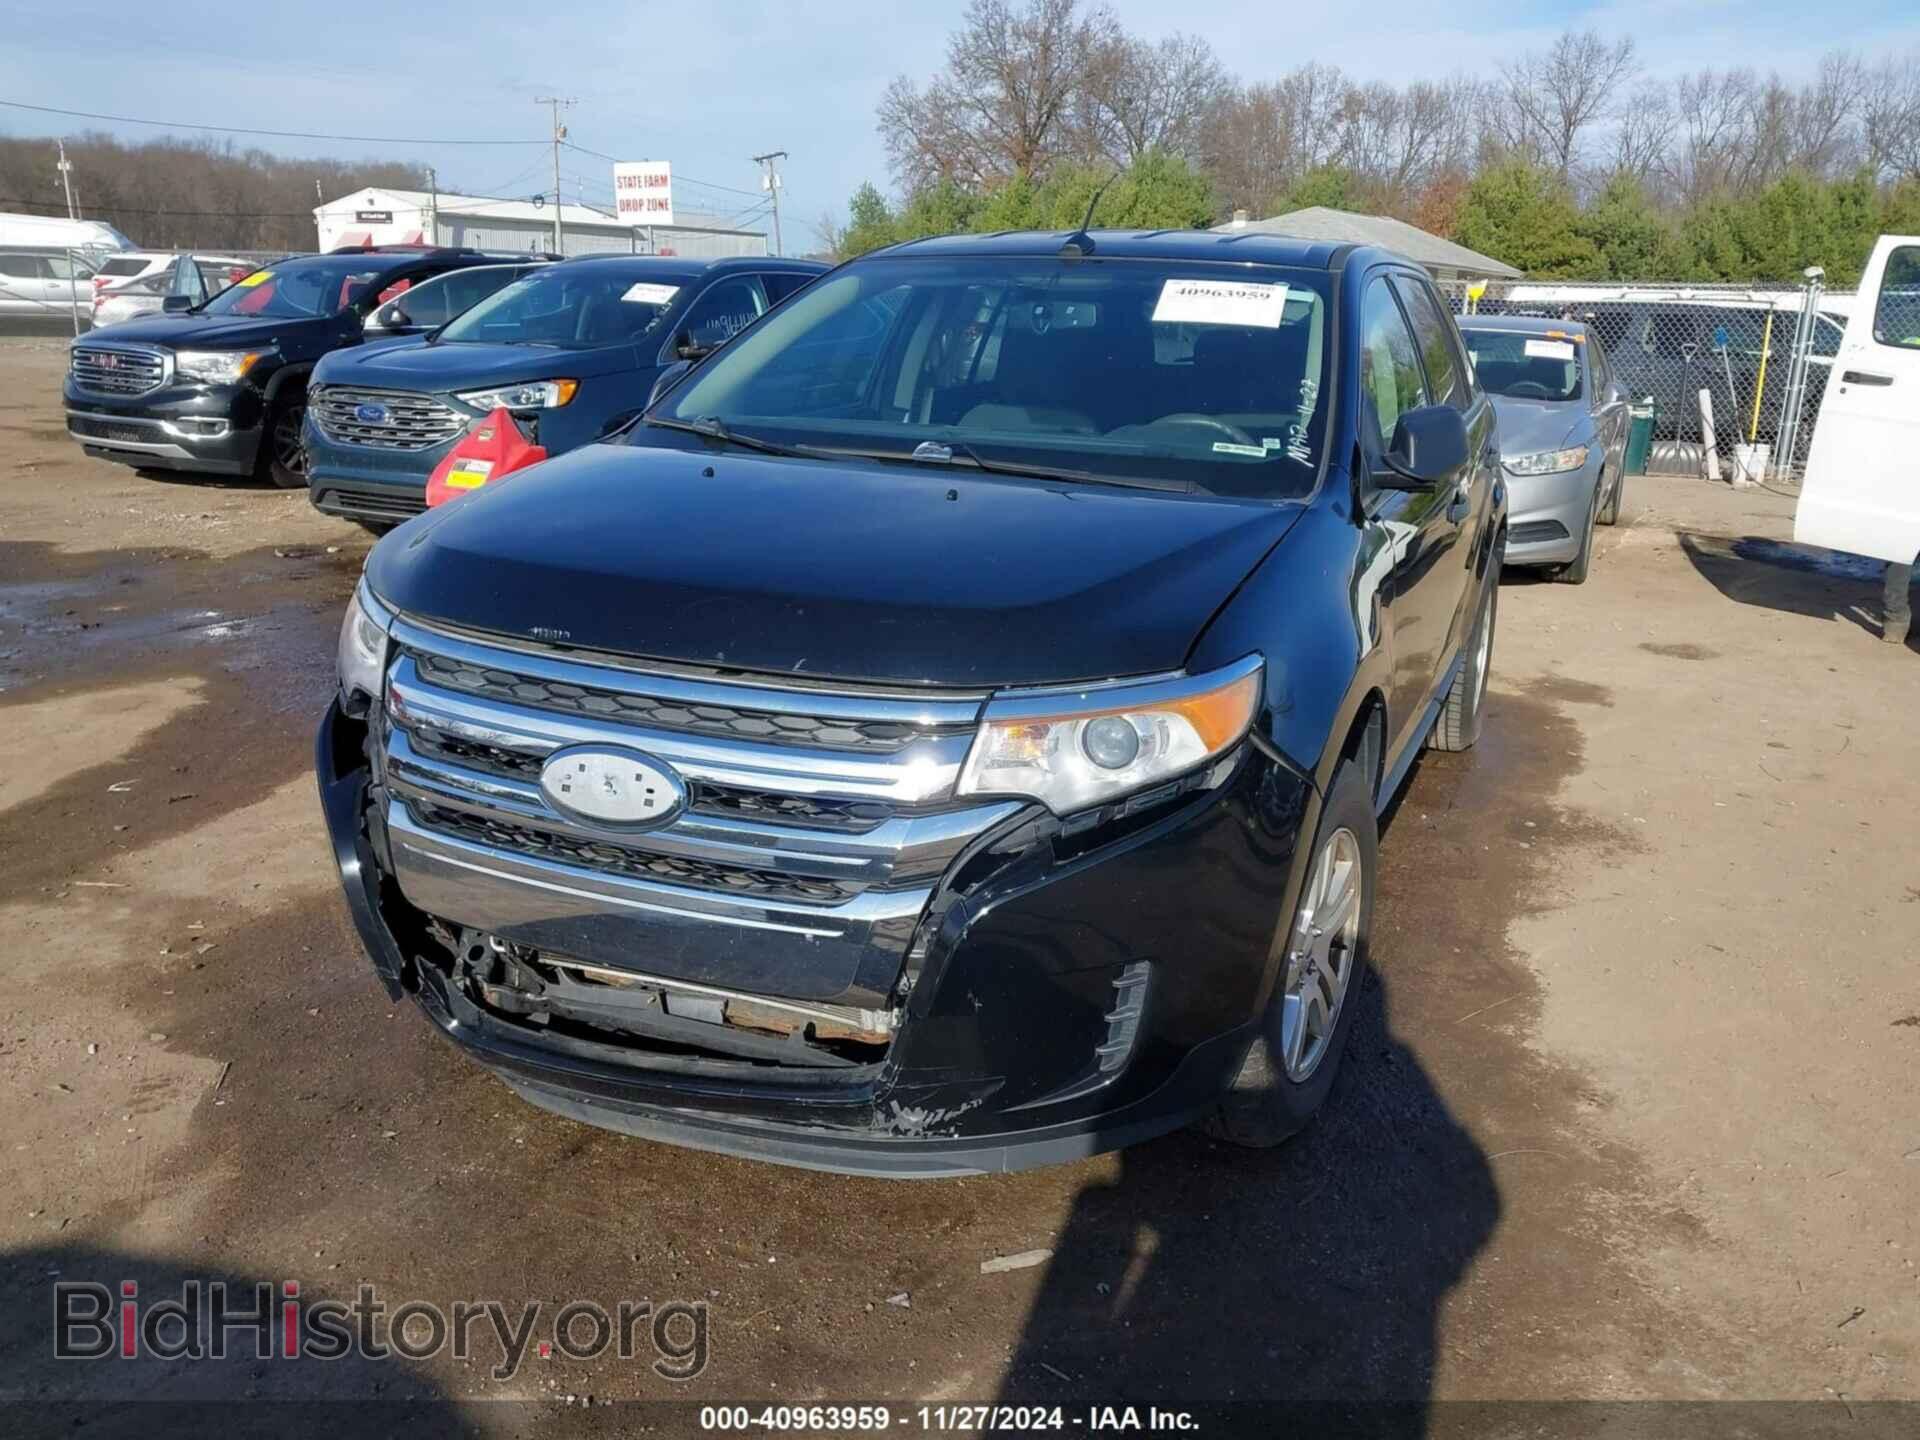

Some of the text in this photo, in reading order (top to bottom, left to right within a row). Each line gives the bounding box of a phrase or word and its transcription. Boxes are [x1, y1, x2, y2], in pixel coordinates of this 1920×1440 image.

[616, 173, 668, 189] STATE FARM
[619, 197, 669, 212] DROP ZONE
[1176, 287, 1271, 300] 40963959
